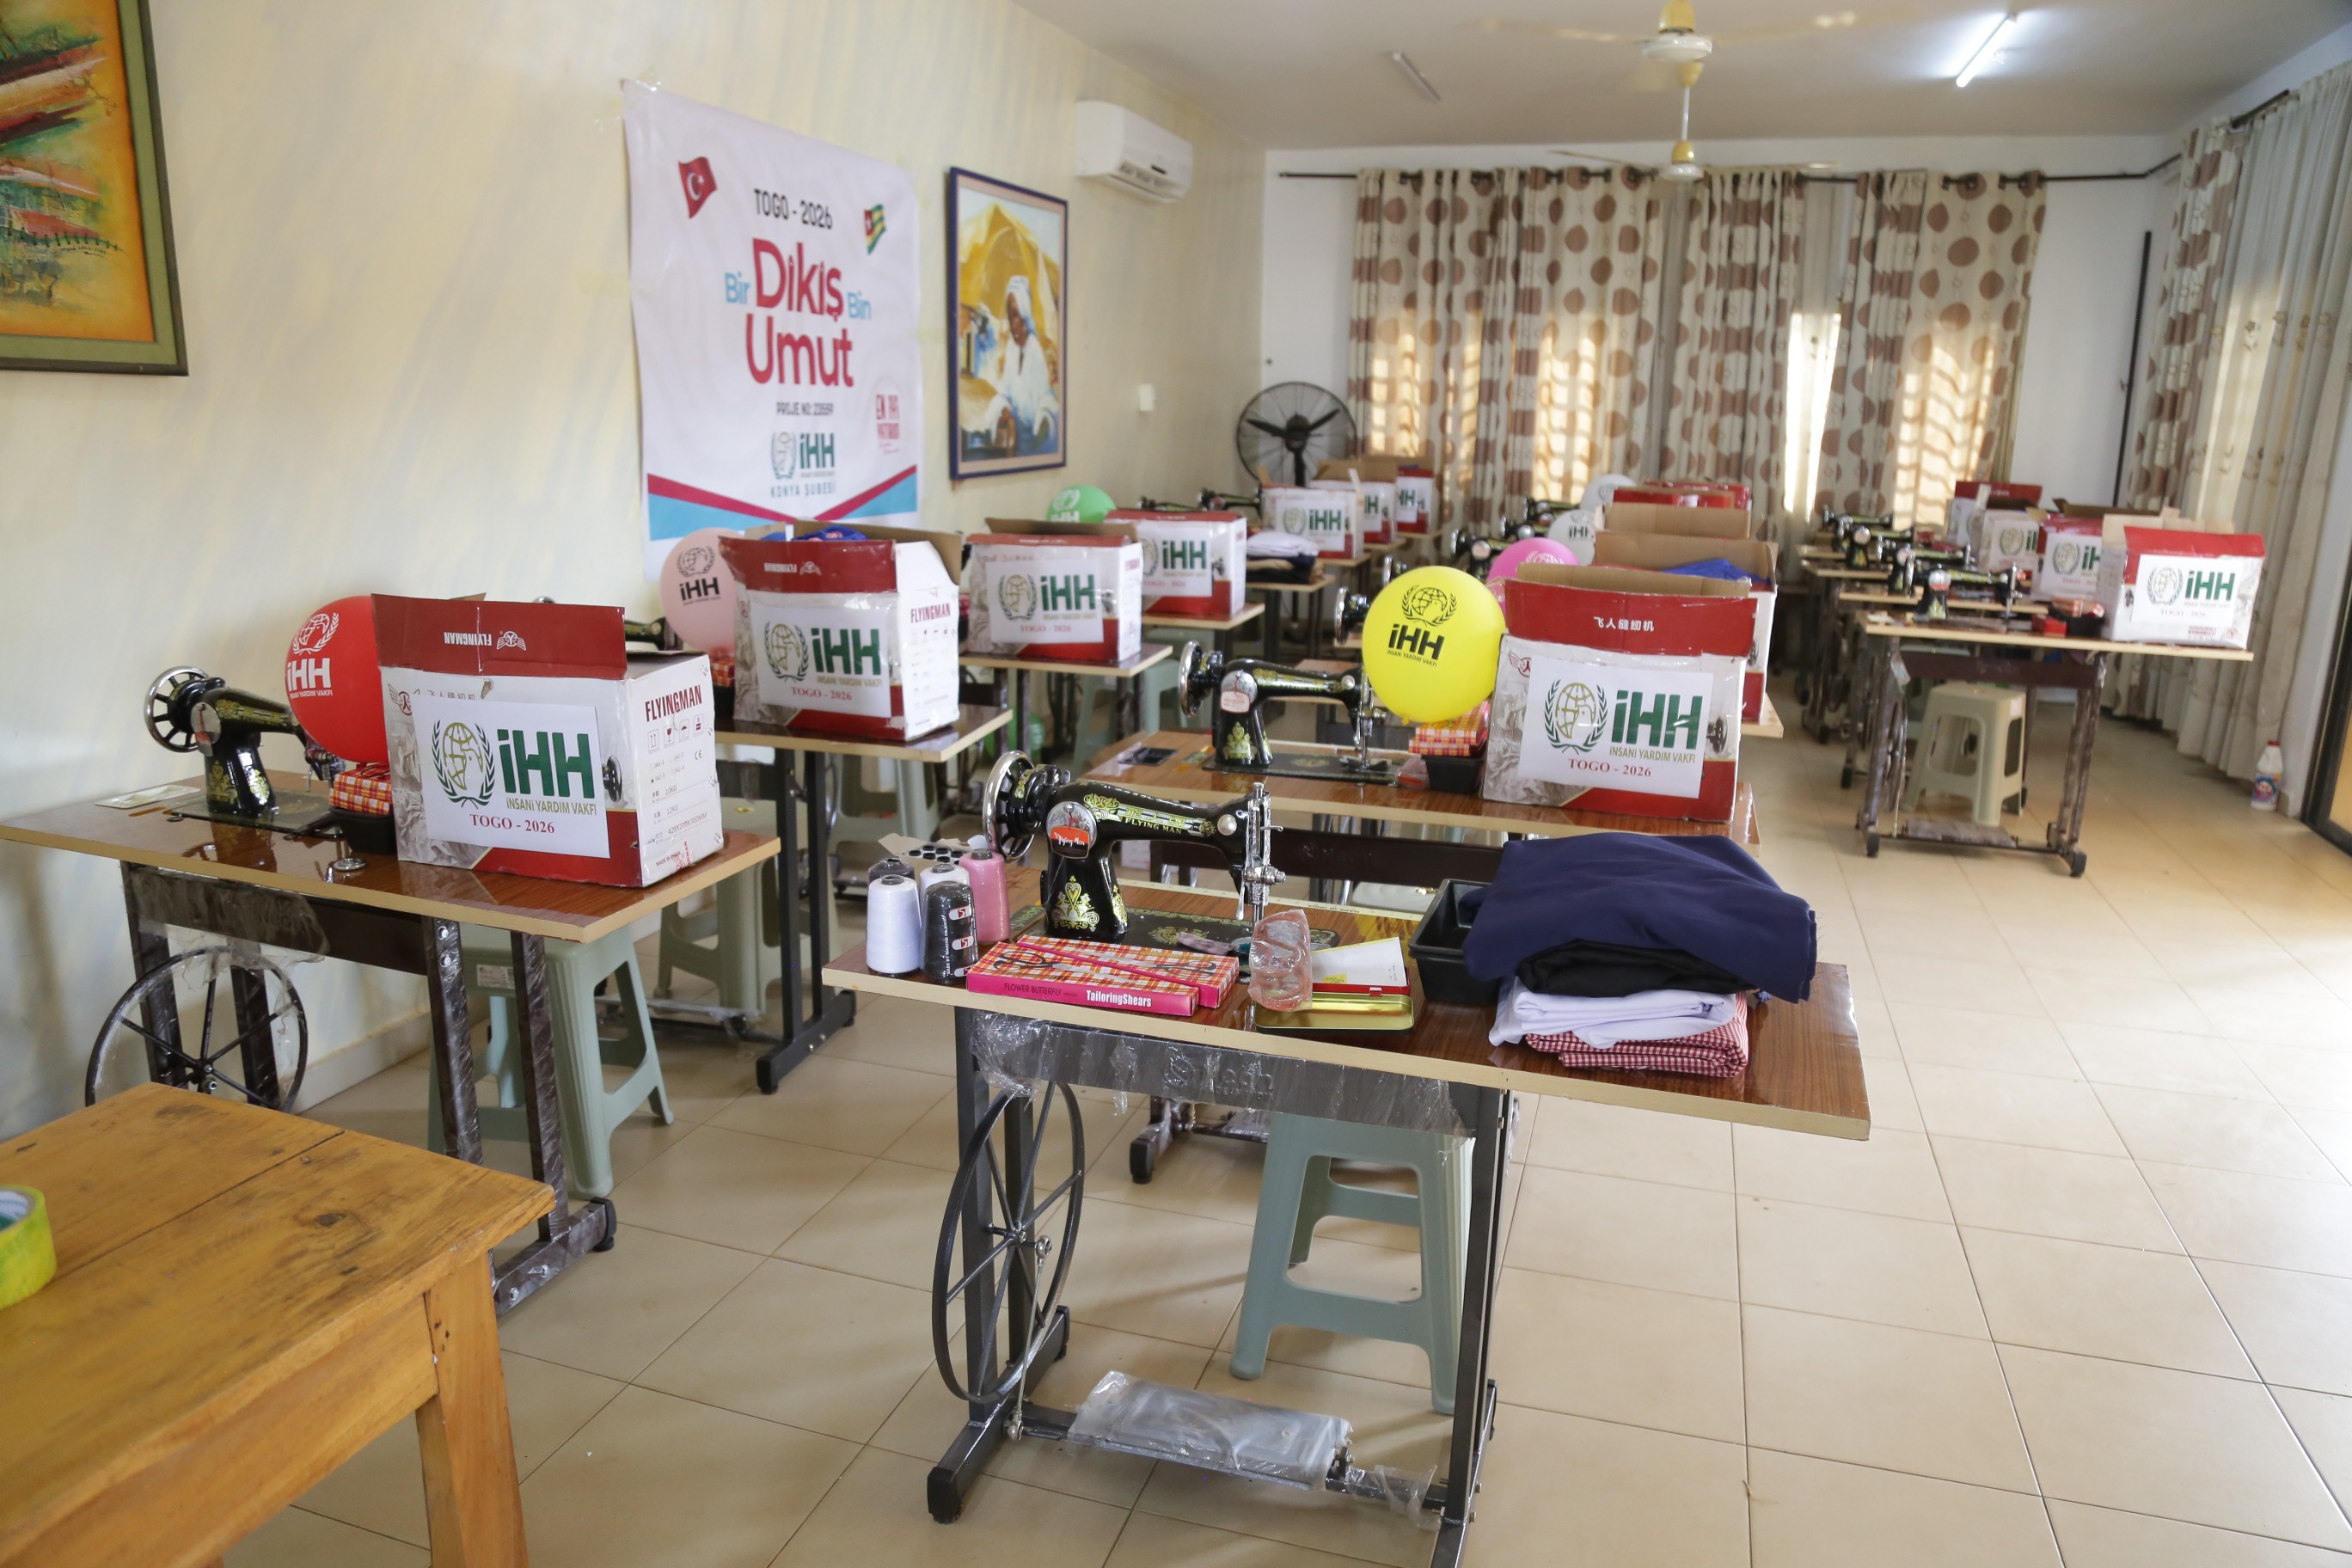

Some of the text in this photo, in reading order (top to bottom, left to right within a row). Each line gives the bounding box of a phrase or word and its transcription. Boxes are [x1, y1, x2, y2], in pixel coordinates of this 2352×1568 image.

[754, 187, 789, 221] TOGO
[799, 199, 833, 230] 2026
[724, 237, 872, 322] Bir Dikiş Bin
[745, 313, 854, 387] Umut
[771, 484, 800, 499] KONYA
[910, 603, 951, 623] FLYINGMAN
[444, 632, 493, 646] FLYINGMAN
[645, 684, 702, 722] FLYINGMAN
[791, 687, 822, 698] TOGO
[830, 690, 852, 701] 2026
[1638, 750, 1671, 762] YARDIM
[1672, 753, 1696, 764] VAKFI
[1568, 757, 1610, 773] TOGO
[1623, 764, 1651, 778] 2026
[535, 799, 570, 814] YARDIM
[571, 802, 597, 816] VAKFI
[469, 813, 512, 830] TOGO
[524, 819, 555, 834] 2026
[1124, 818, 1183, 834] FLYING MAN
[1073, 836, 1086, 846] Man
[1004, 983, 1030, 993] FLOWER
[1031, 986, 1062, 996] BUTTERFLY
[1086, 989, 1152, 1008] TailoringShears
